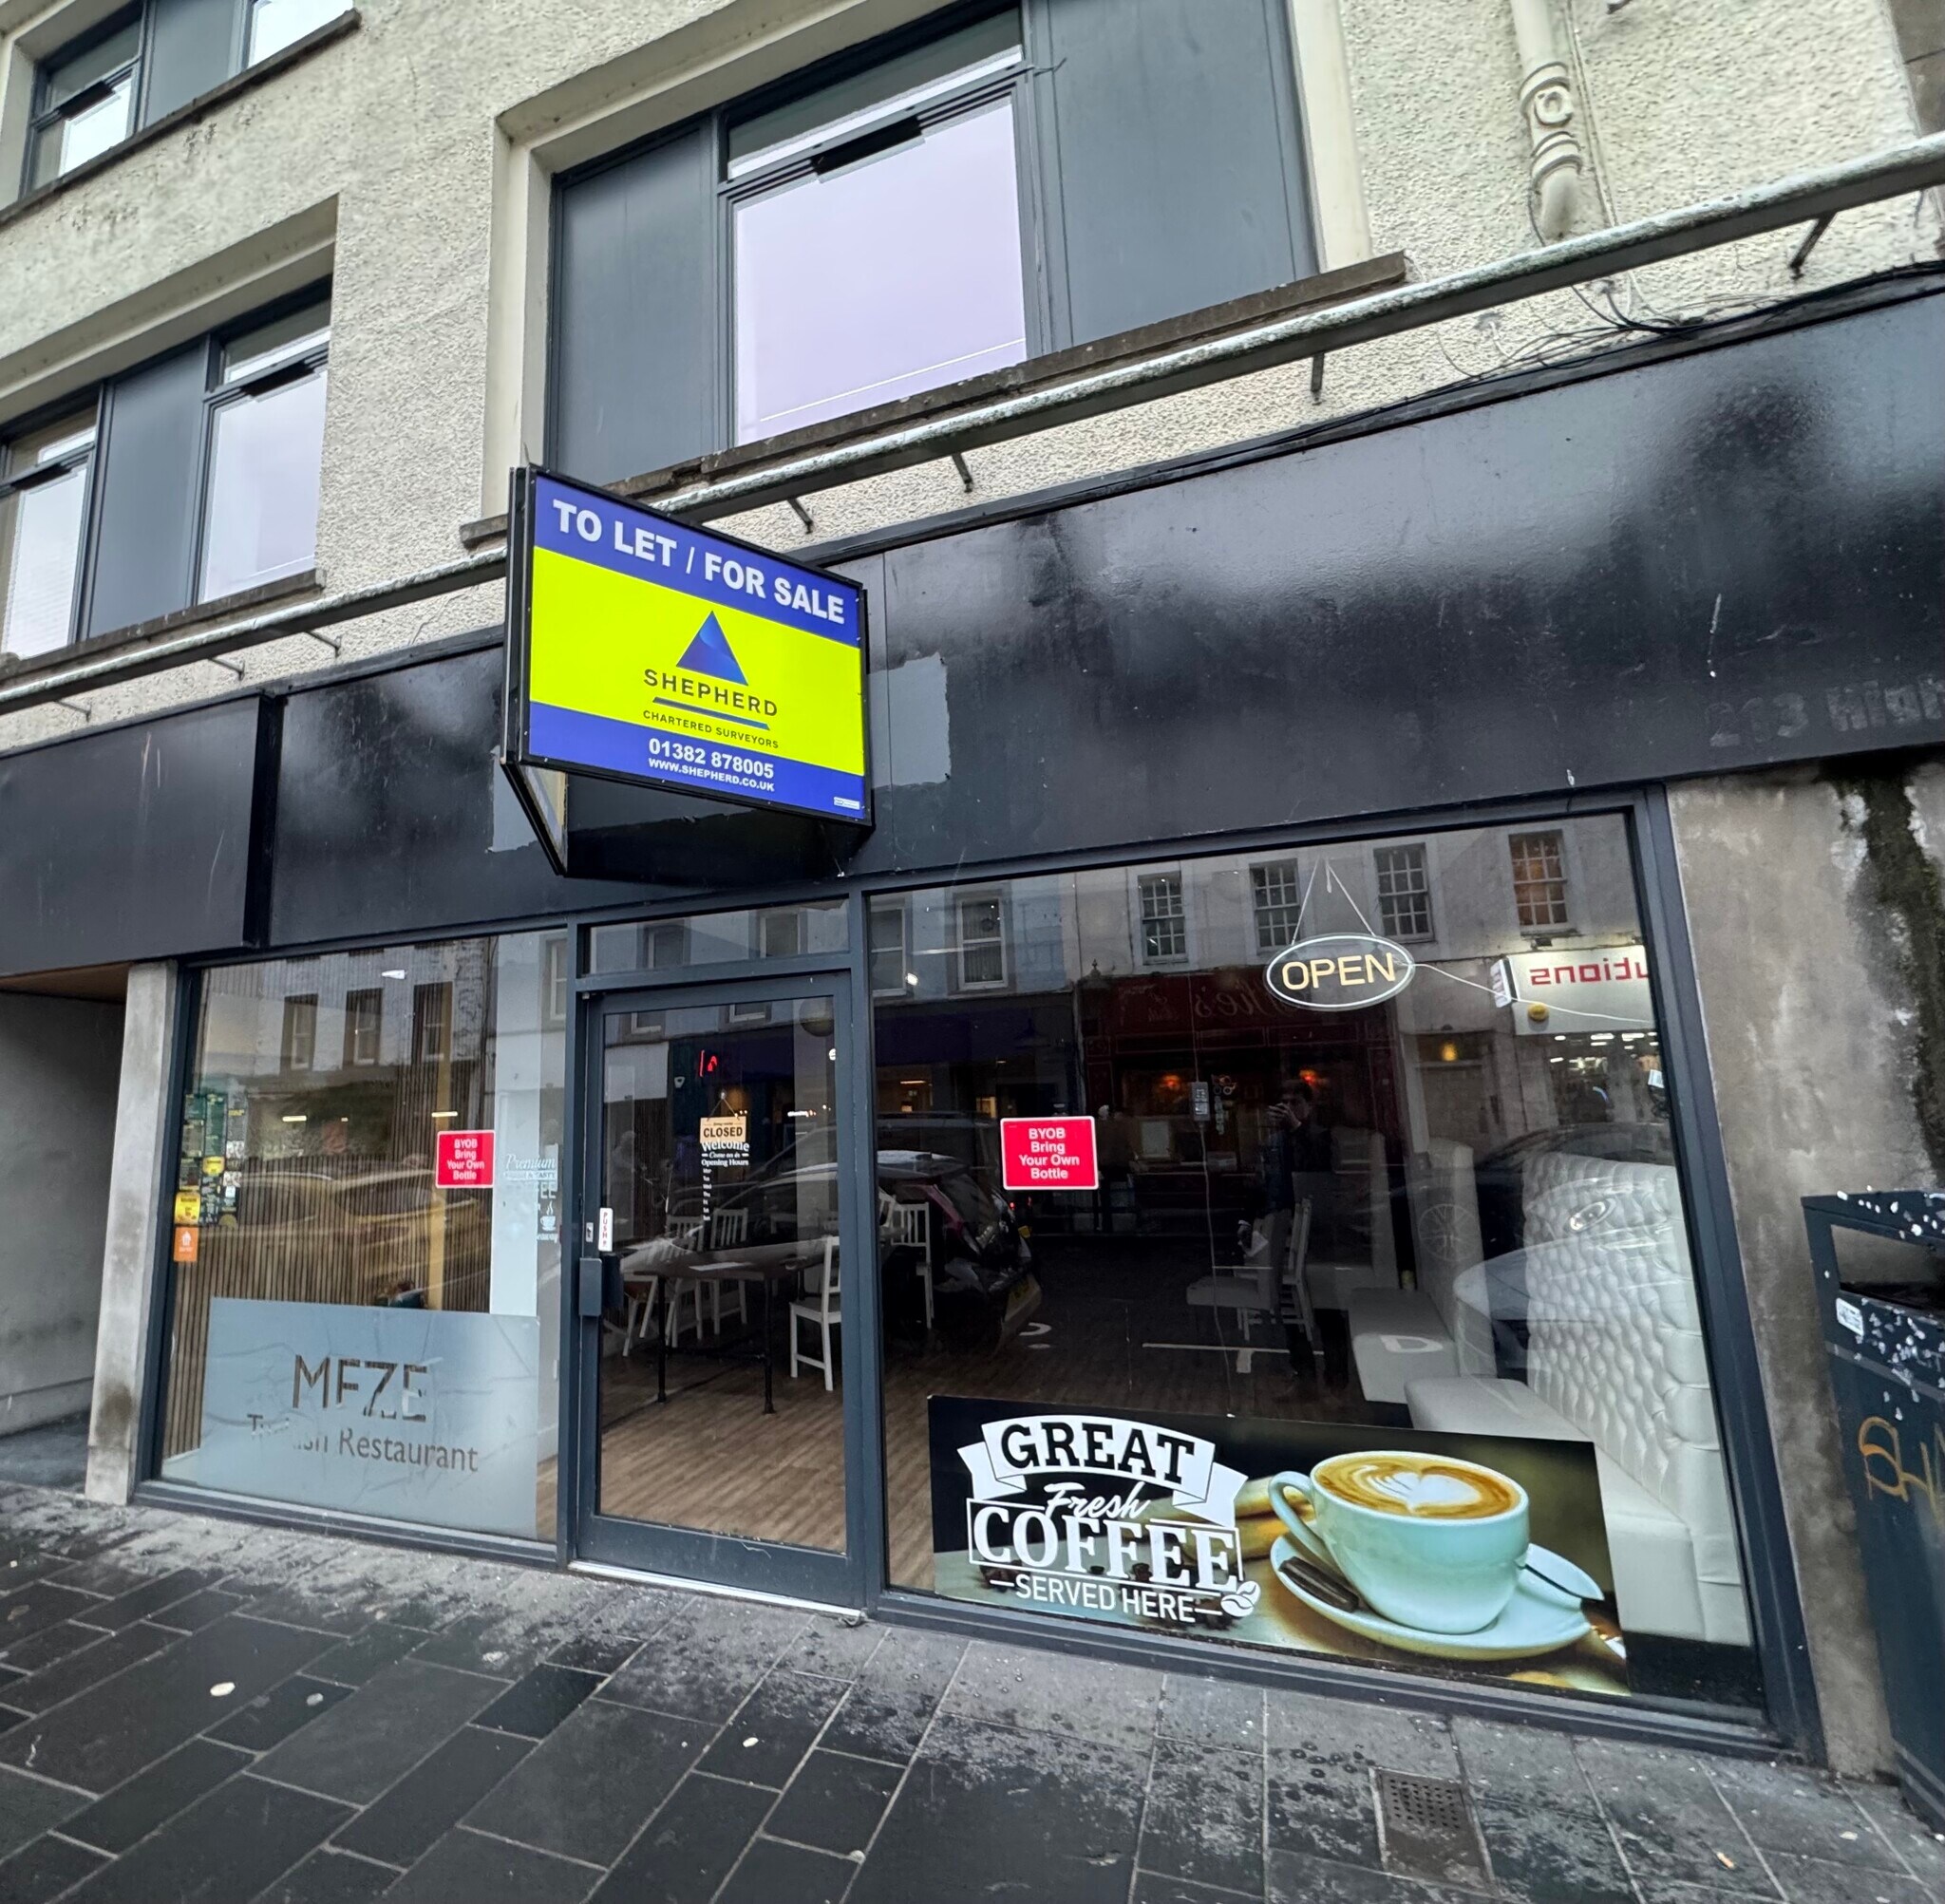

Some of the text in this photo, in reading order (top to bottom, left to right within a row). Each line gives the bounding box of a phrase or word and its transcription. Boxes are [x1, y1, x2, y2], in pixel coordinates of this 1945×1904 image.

[553, 499, 845, 625] TO LET / FOR SALE
[643, 668, 778, 717] SHEPHERD
[643, 709, 779, 749] CHARTERED SURVEYORS
[649, 737, 774, 779] 01382 878005
[648, 757, 775, 792] WWW.SHEPHERD.CO.UK
[1281, 952, 1396, 990] OPEN
[454, 1138, 478, 1149] BYOB
[703, 1126, 743, 1138] CLOSED
[1029, 1127, 1066, 1140] BYOB
[455, 1149, 477, 1160] Bring
[701, 1141, 750, 1152] Welcome
[1030, 1141, 1066, 1155] Bring
[446, 1159, 485, 1169] Your Own
[701, 1159, 728, 1167] Opening
[1018, 1154, 1080, 1166] Your Own
[453, 1170, 477, 1180] Bottle
[1030, 1167, 1068, 1179] Bottle
[340, 1427, 479, 1472] Restaurant
[1001, 1422, 1195, 1484] GREAT
[1044, 1481, 1151, 1520] Fresh
[973, 1506, 1237, 1593] COFFEE
[1015, 1574, 1196, 1623] SERVED HERE
